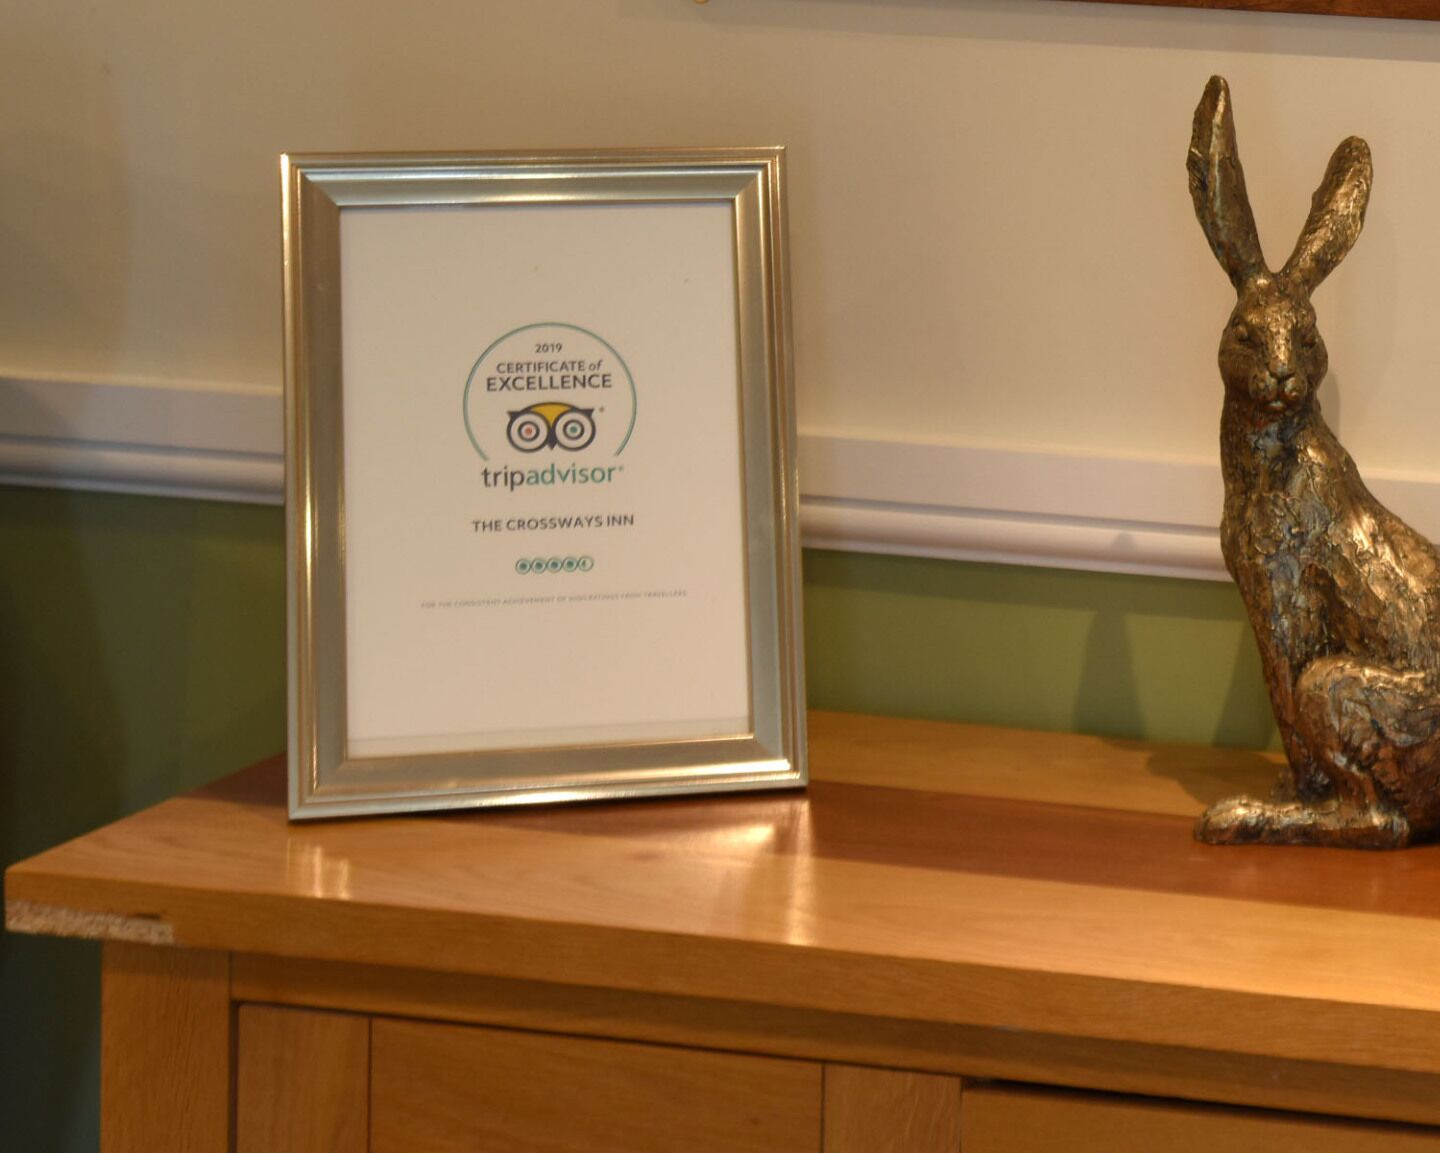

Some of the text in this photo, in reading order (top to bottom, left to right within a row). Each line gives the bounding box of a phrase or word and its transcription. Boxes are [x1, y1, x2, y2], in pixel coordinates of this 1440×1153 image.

[535, 342, 563, 354] 2019
[496, 360, 603, 374] CERTIFICATE of
[486, 373, 613, 392] EXCELLENCE
[481, 462, 617, 492] tripadvisor
[472, 514, 635, 533] THE CROSSWAYS INN
